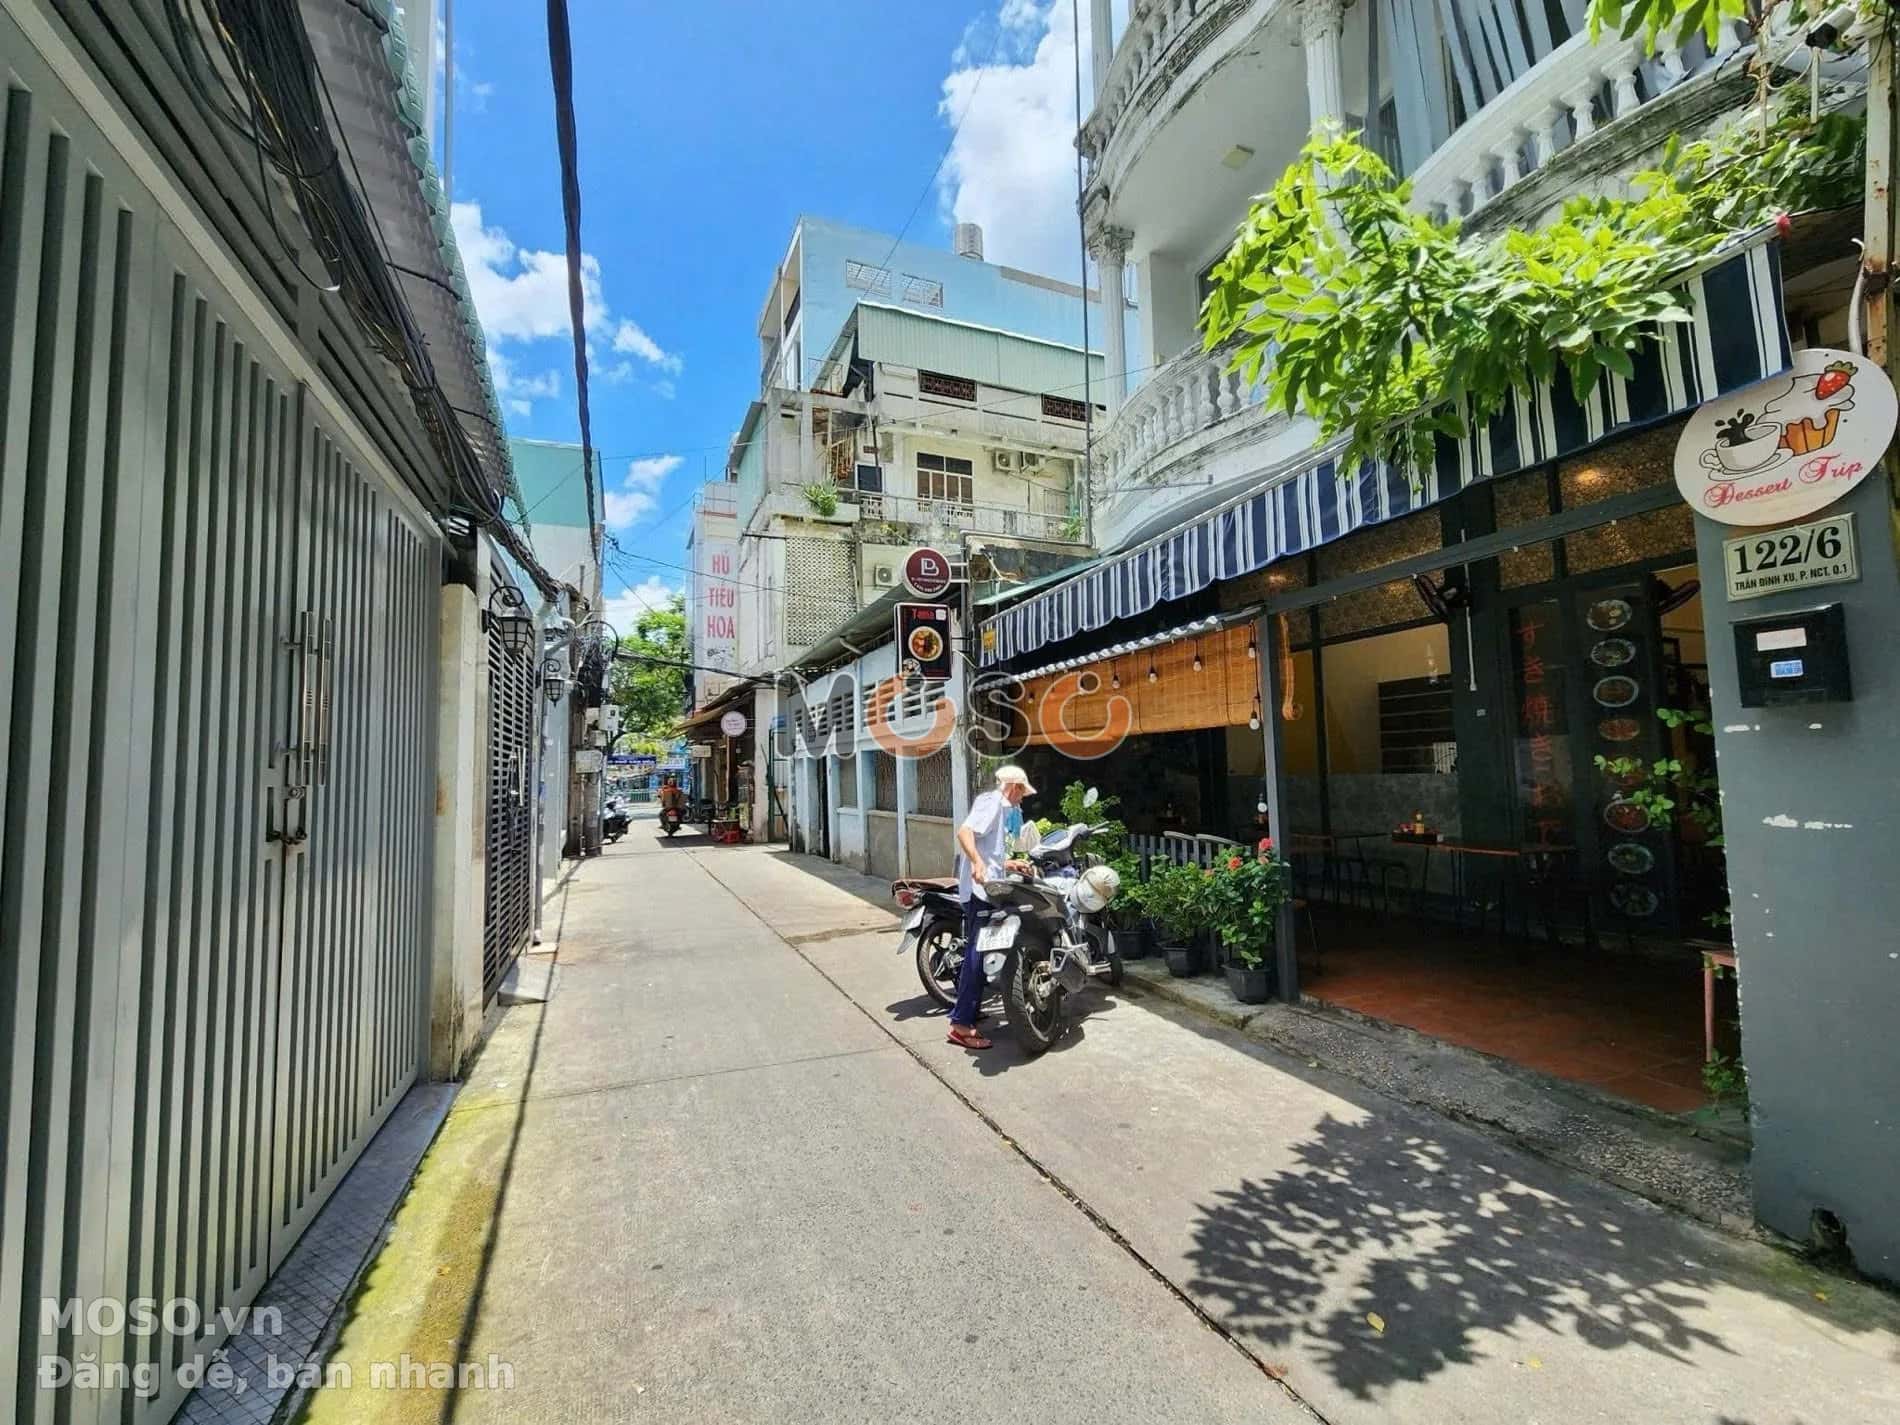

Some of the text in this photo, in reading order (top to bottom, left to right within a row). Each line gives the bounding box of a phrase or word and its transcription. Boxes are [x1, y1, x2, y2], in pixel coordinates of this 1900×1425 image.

[1704, 453, 1864, 508] Dessert Trip
[1733, 526, 1842, 575] 122/6
[706, 614, 736, 640] HOA
